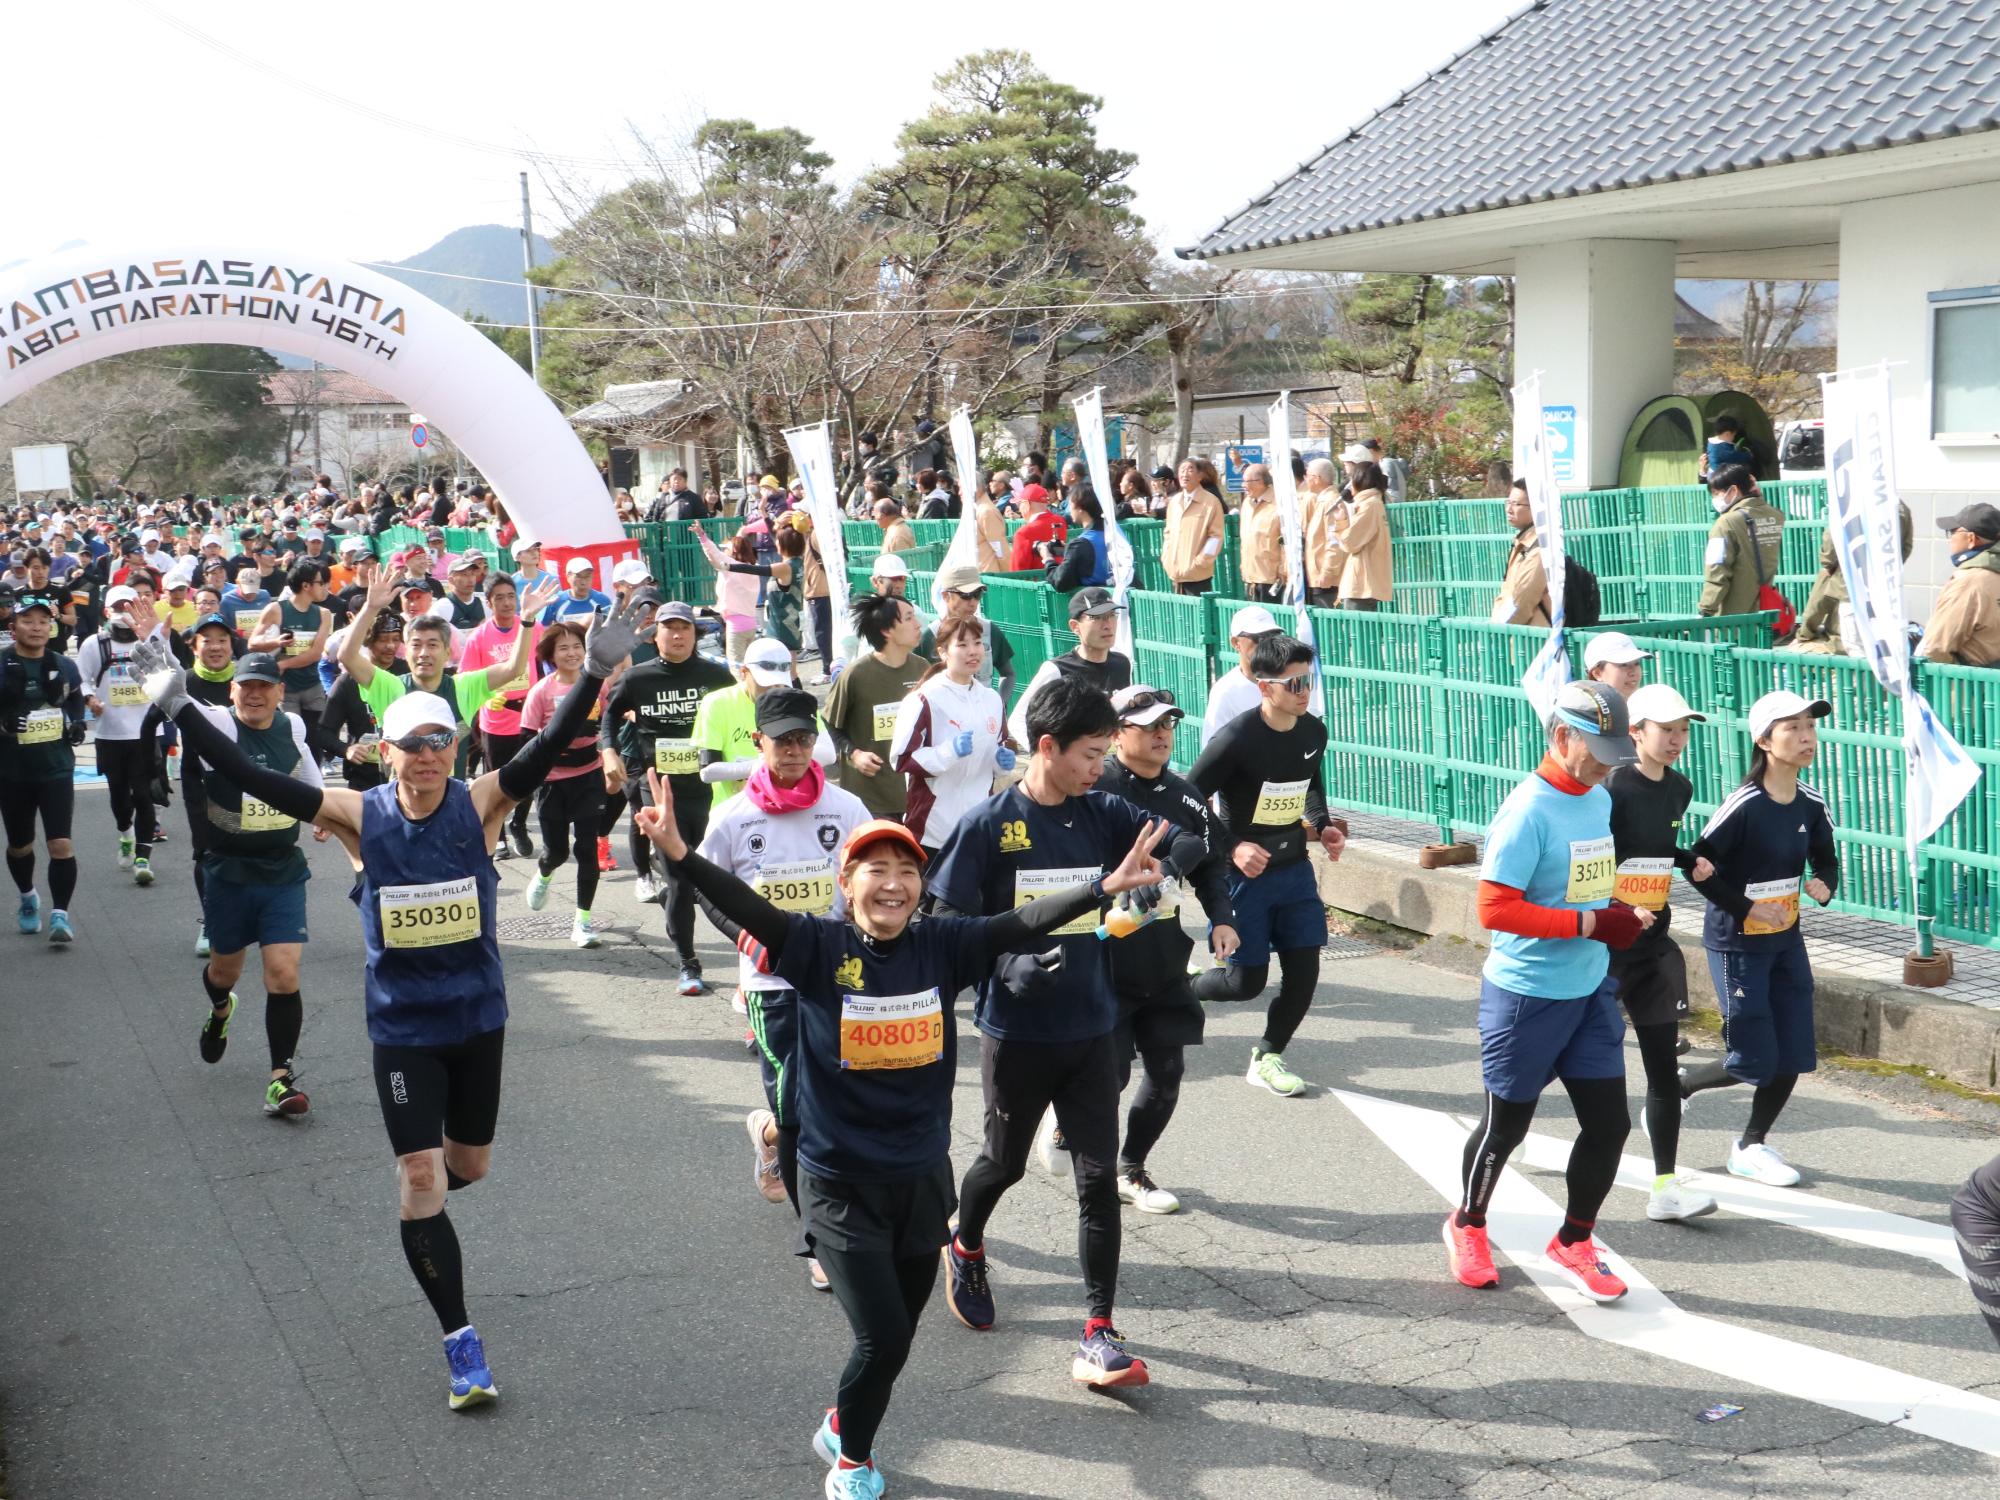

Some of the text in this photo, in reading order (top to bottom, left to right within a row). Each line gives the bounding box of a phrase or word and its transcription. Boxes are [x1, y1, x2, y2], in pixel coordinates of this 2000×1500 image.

[7, 293, 397, 369] ABC MARATHON 46TH
[657, 688, 698, 702] WILD
[1000, 820, 1027, 843] 39
[1575, 859, 1612, 882] 35211
[442, 884, 473, 896] PILLAR
[760, 881, 820, 900] 35031
[1619, 877, 1665, 893] 40844
[390, 904, 476, 928] 35030 D
[849, 1020, 941, 1046] 40803 D
[389, 1071, 408, 1104] 2XU
